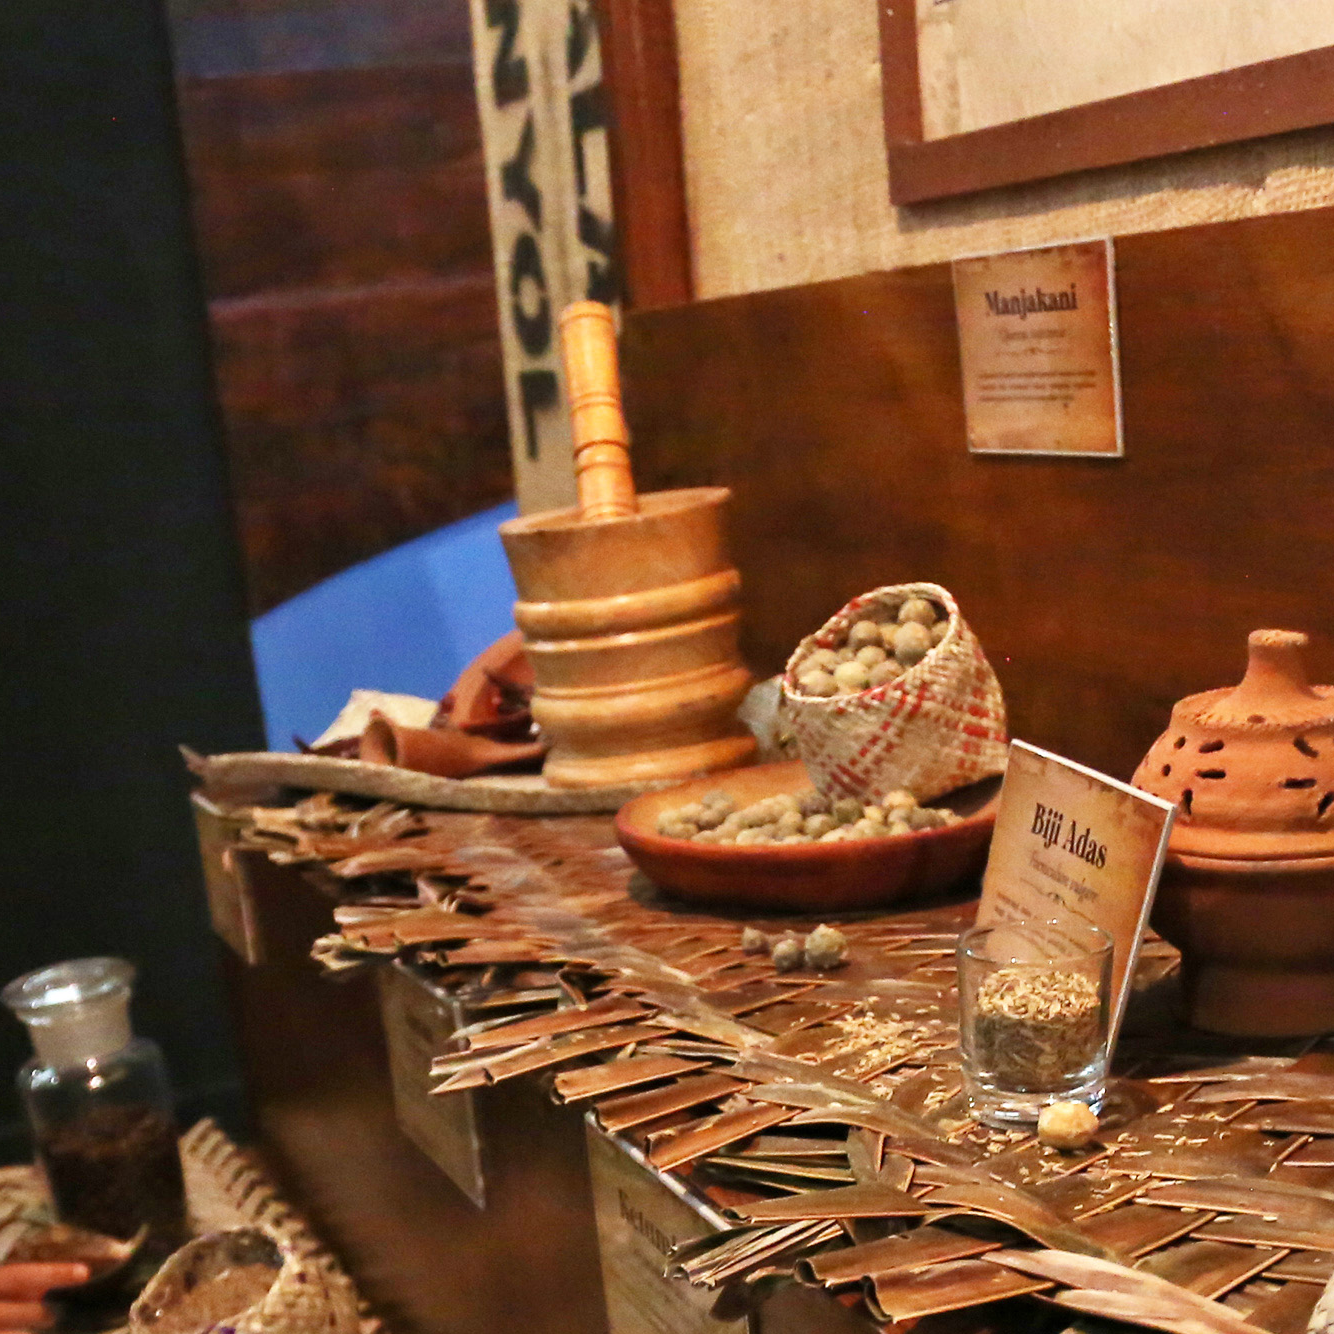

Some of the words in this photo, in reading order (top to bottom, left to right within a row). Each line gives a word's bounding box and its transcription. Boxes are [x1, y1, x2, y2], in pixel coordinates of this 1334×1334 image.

[984, 282, 1078, 320] Manjakani
[1030, 802, 1064, 849] Biji
[1062, 820, 1108, 870] Adas
